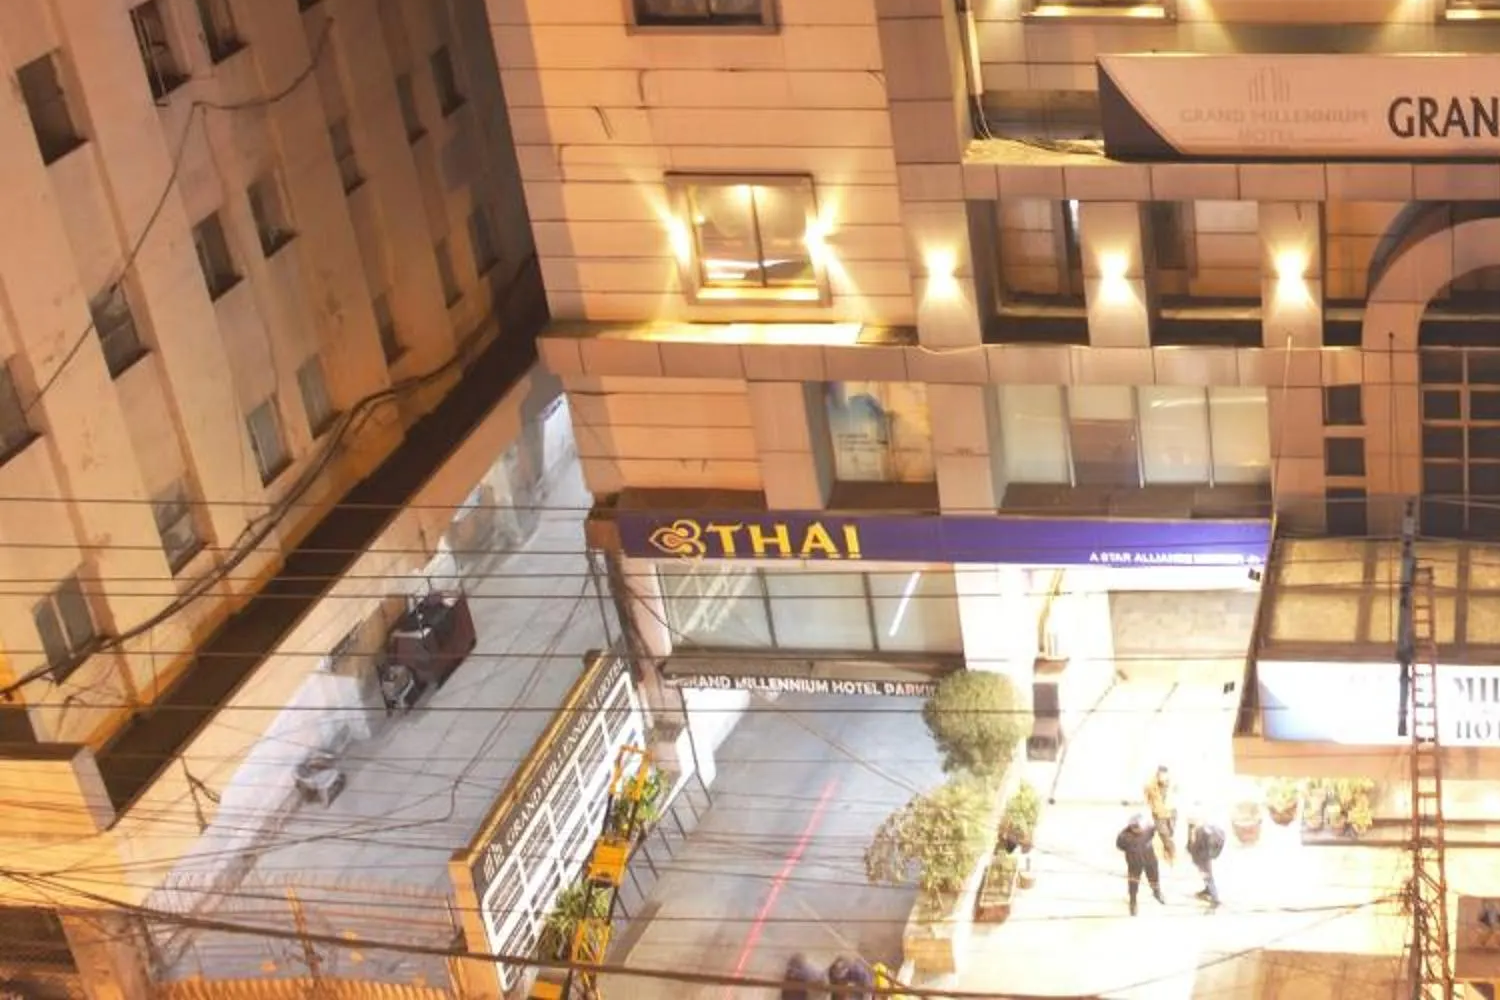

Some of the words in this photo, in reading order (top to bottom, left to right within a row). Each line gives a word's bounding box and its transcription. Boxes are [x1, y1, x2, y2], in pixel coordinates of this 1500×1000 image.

[704, 521, 862, 558] THAI
[734, 676, 828, 693] MILLENNIUM
[832, 679, 882, 695] HOTEL
